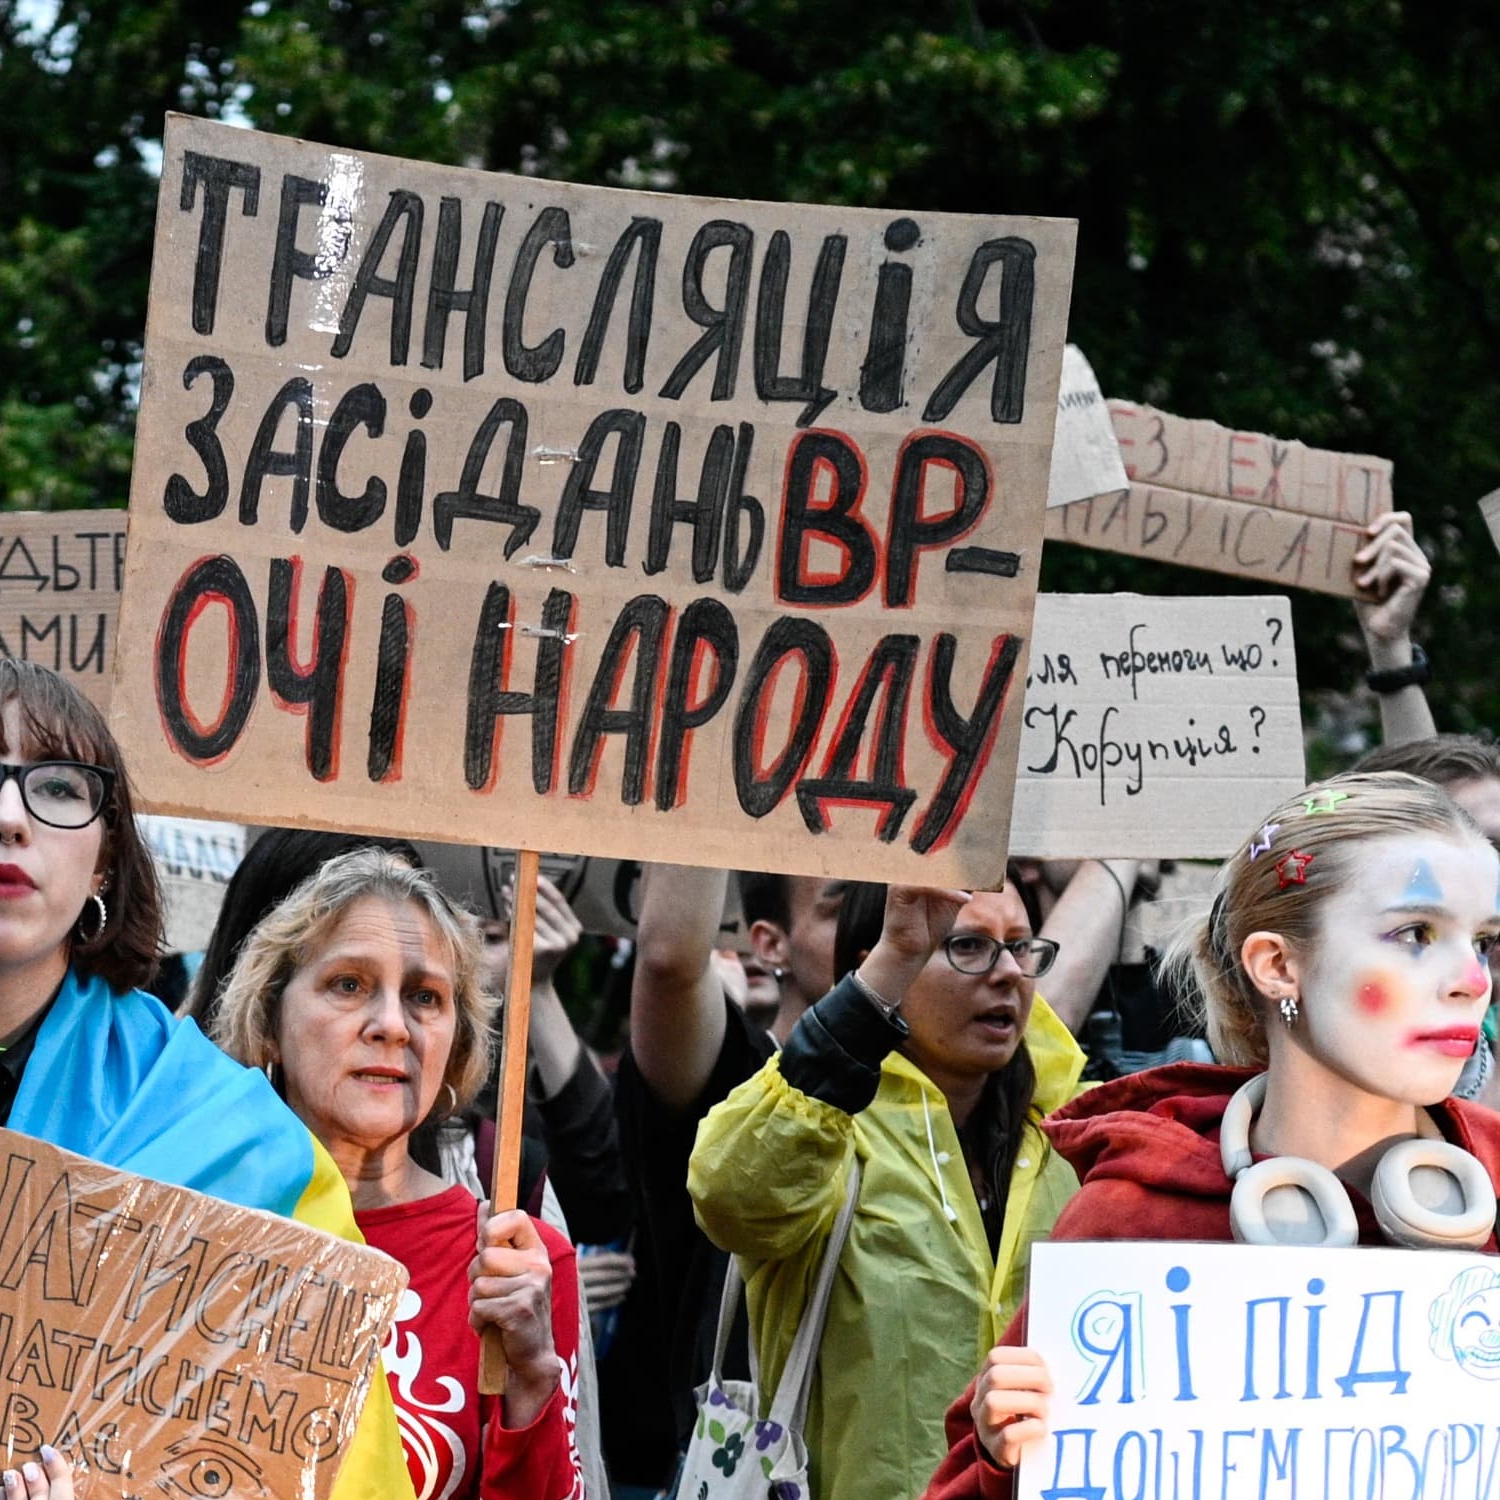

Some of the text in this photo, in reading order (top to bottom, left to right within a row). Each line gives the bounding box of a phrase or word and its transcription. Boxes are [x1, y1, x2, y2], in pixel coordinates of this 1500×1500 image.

[180, 150, 1034, 429] ТРАНСЛЯЦІЯ
[164, 355, 764, 590] ЗАСІДАНЬ
[156, 550, 1023, 853] ОЧІ НАРОДУ
[1025, 704, 1266, 806] Корупція?
[1027, 651, 1076, 689] ля
[1074, 1292, 1142, 1406] Я
[1239, 1277, 1411, 1402] ПІД
